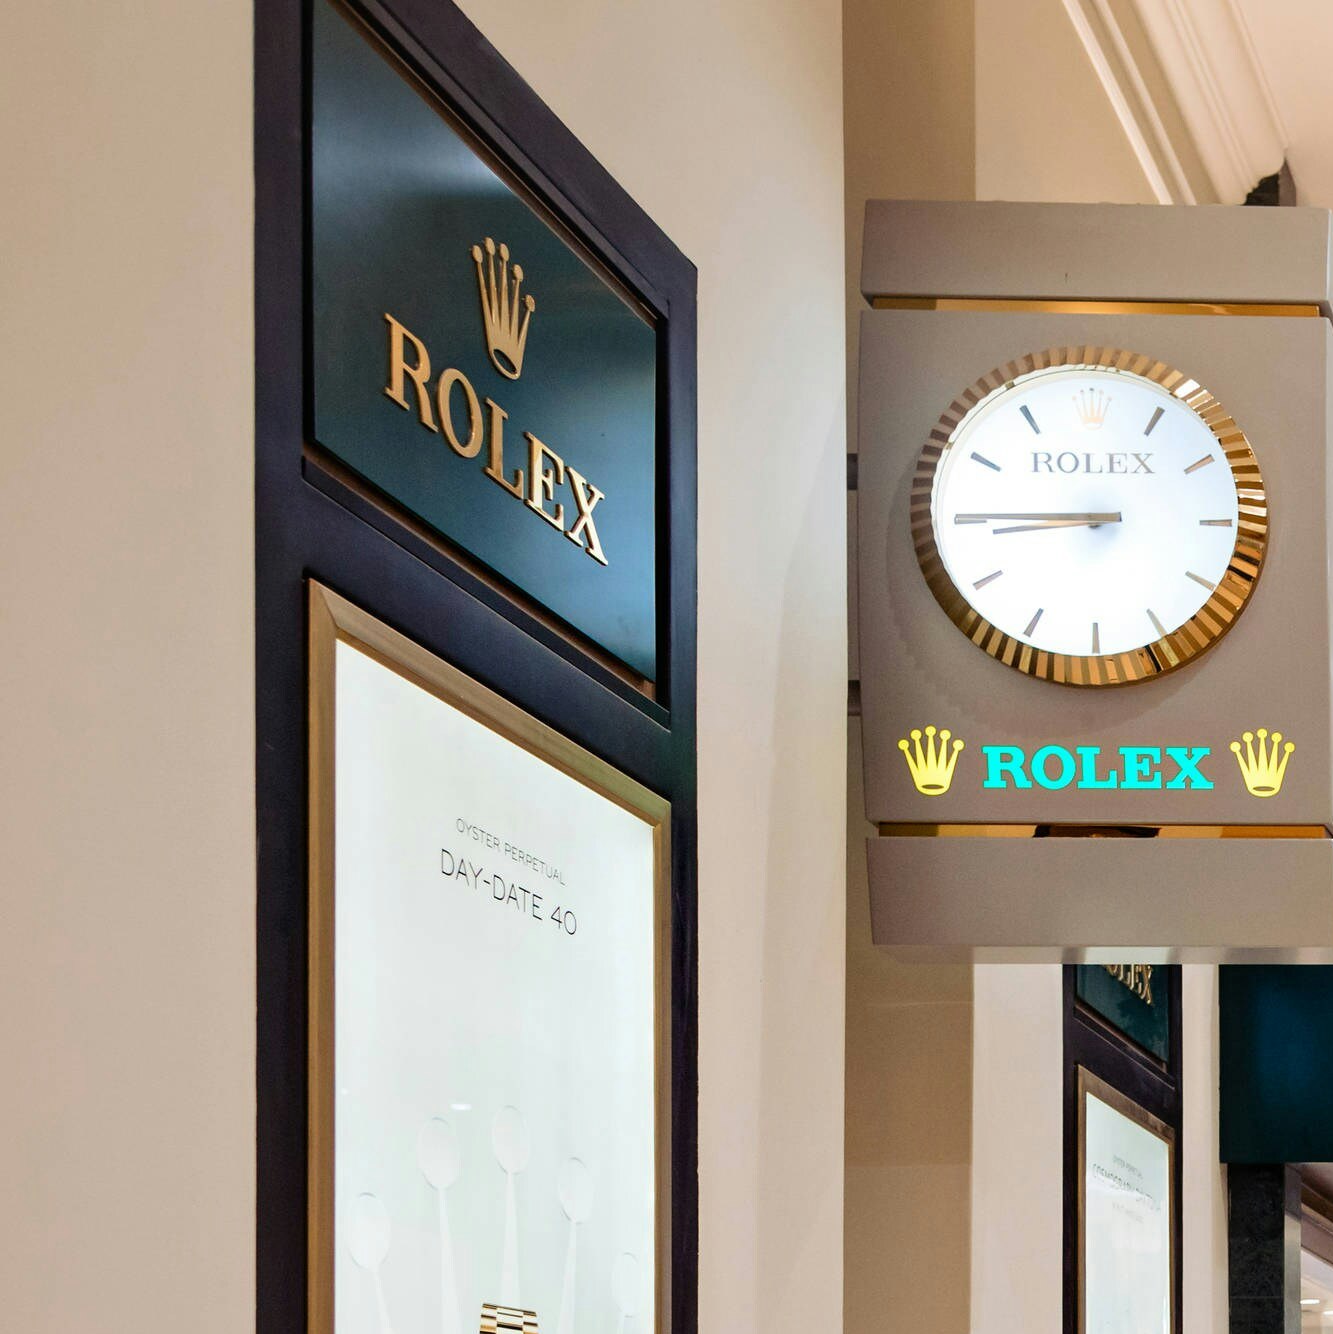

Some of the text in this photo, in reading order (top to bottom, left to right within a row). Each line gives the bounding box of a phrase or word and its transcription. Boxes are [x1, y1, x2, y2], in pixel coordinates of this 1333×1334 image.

[384, 313, 608, 566] ROLEX
[1030, 451, 1155, 475] ROLEX
[982, 745, 1214, 790] ROLEX
[456, 818, 566, 887] OYSTER PERPETUAL
[441, 848, 577, 935] DAY-DATE 40
